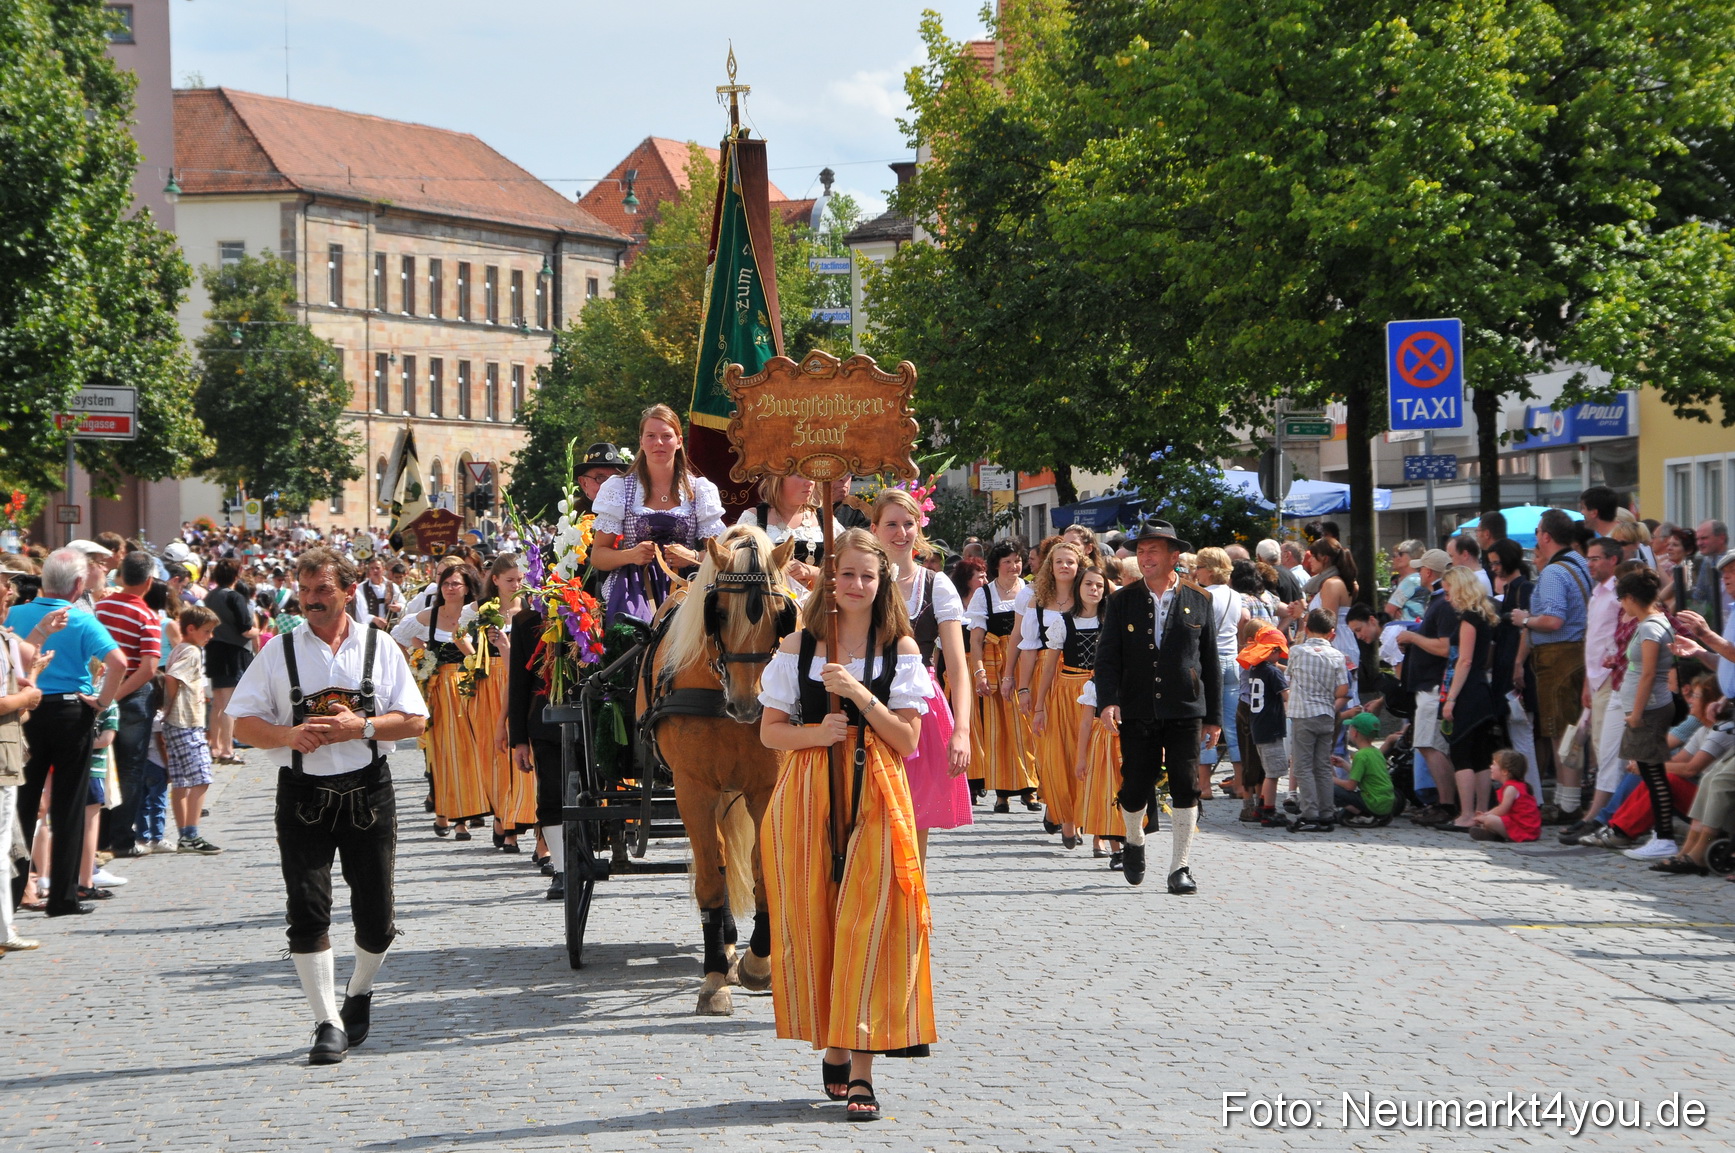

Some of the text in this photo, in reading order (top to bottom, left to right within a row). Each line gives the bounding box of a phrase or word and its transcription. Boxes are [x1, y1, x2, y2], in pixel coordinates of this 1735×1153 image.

[810, 261, 849, 270] Ctactlinsen
[811, 311, 850, 320] Rdenstock
[71, 393, 114, 408] system
[1396, 396, 1456, 421] TAXI
[1576, 403, 1625, 420] APOLLO
[791, 420, 849, 449] Stauf
[811, 469, 832, 477] 1965
[1249, 677, 1265, 713] 8
